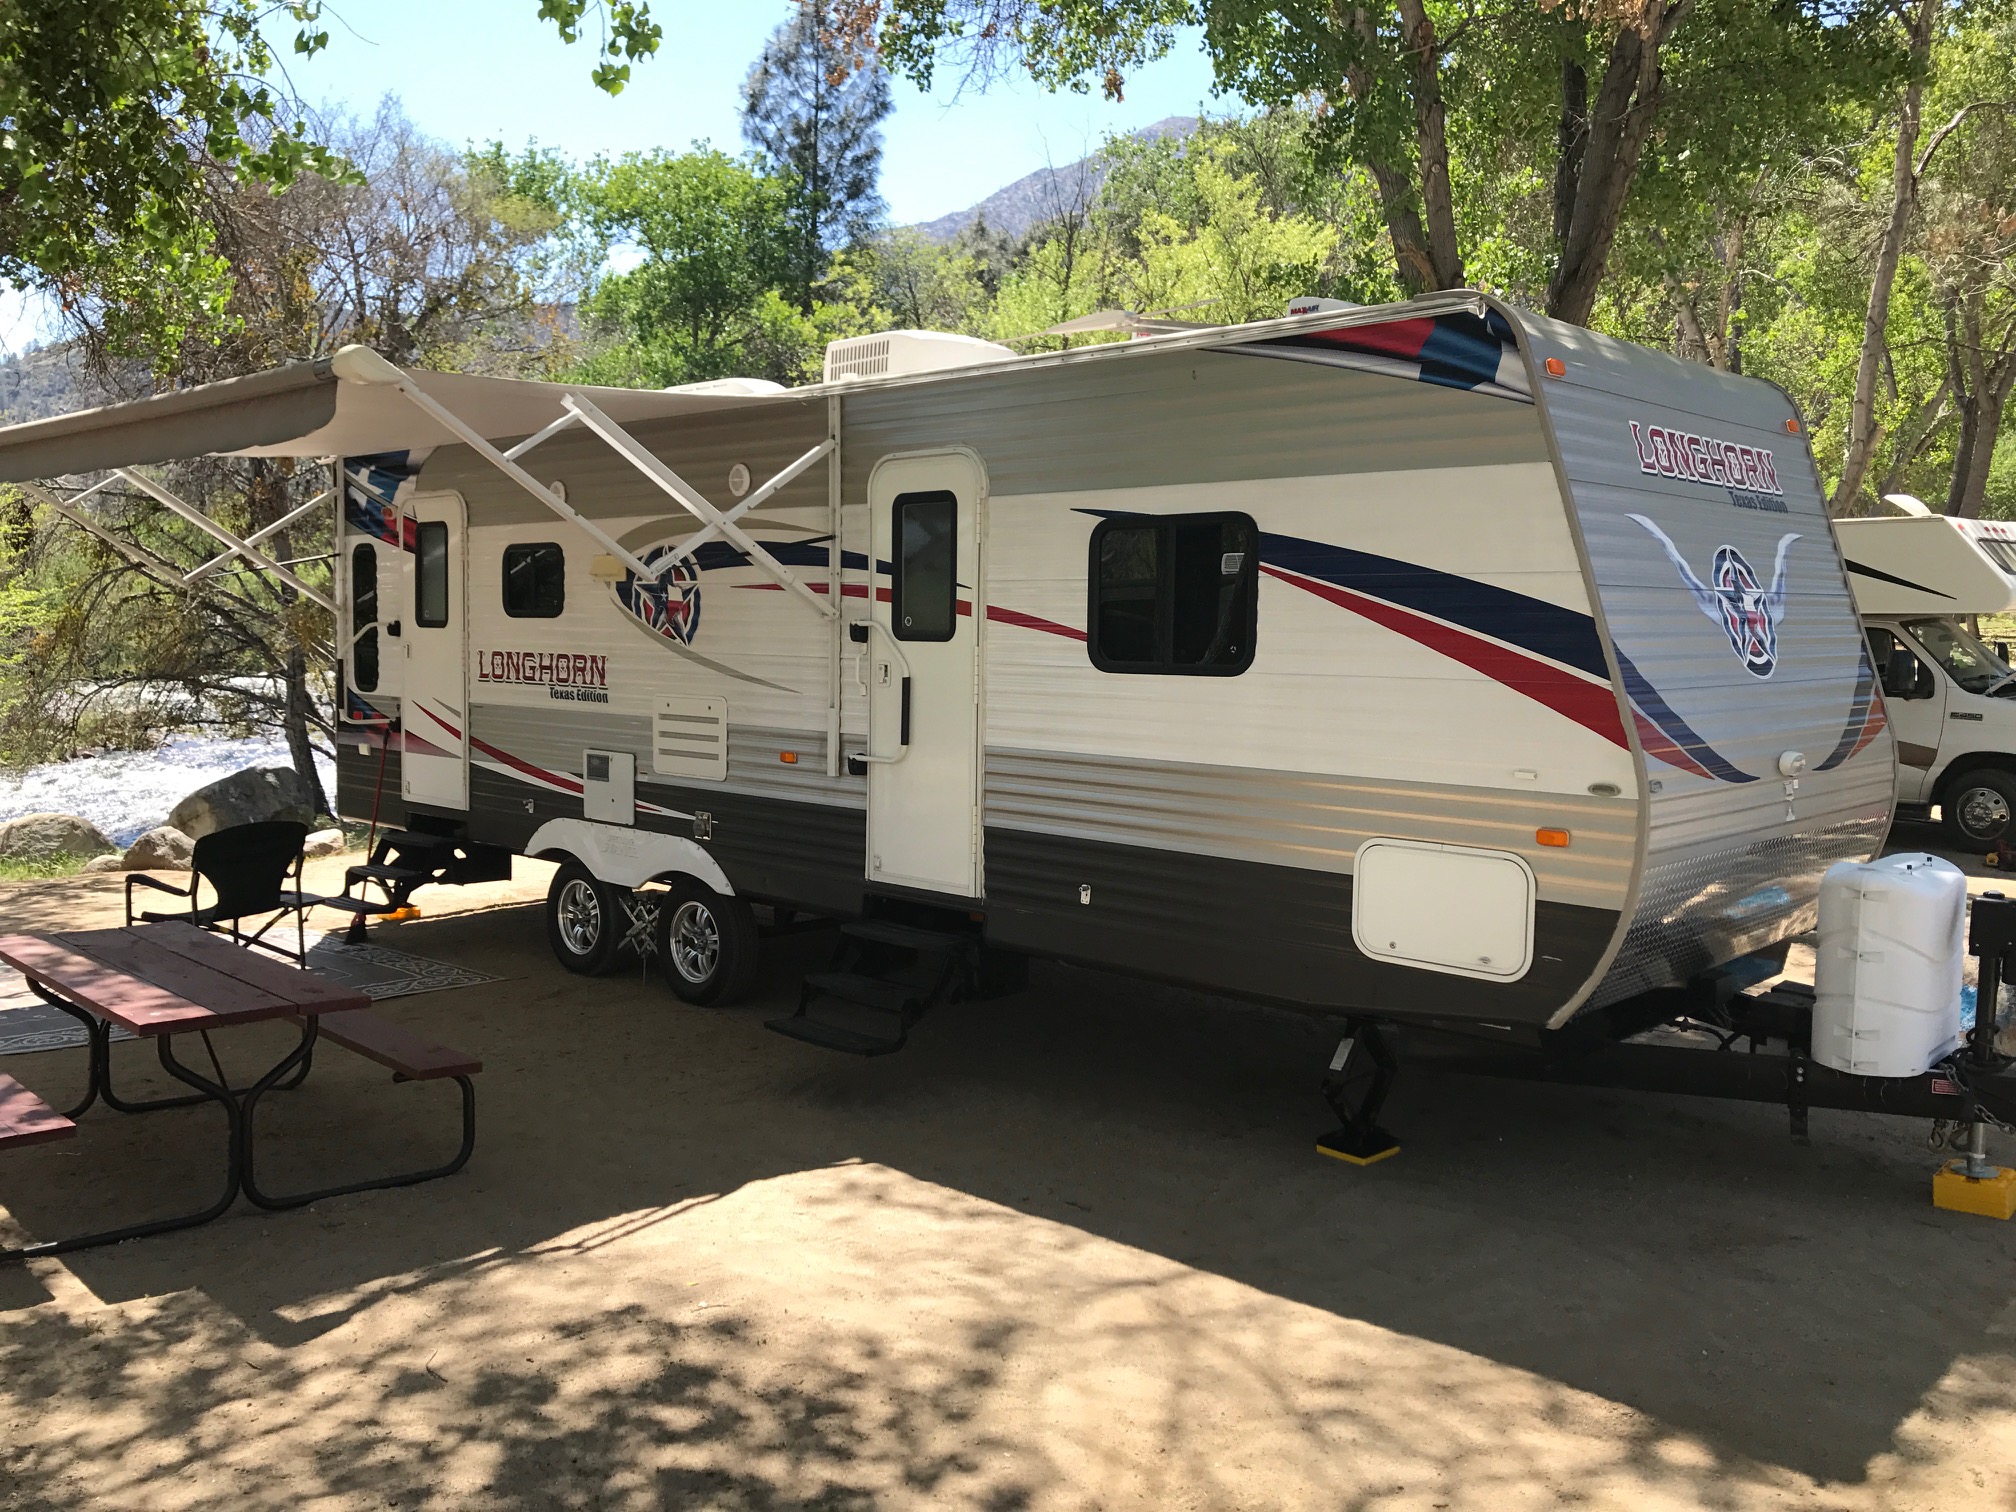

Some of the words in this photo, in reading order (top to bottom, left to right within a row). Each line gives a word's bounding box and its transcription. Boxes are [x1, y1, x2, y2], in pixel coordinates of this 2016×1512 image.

[1628, 420, 1784, 495] LONGHORN
[1728, 491, 1757, 510] Texas
[1756, 495, 1789, 514] Edition
[477, 650, 609, 690] LONGHORN
[549, 687, 575, 701] Texas
[577, 689, 609, 703] Edition
